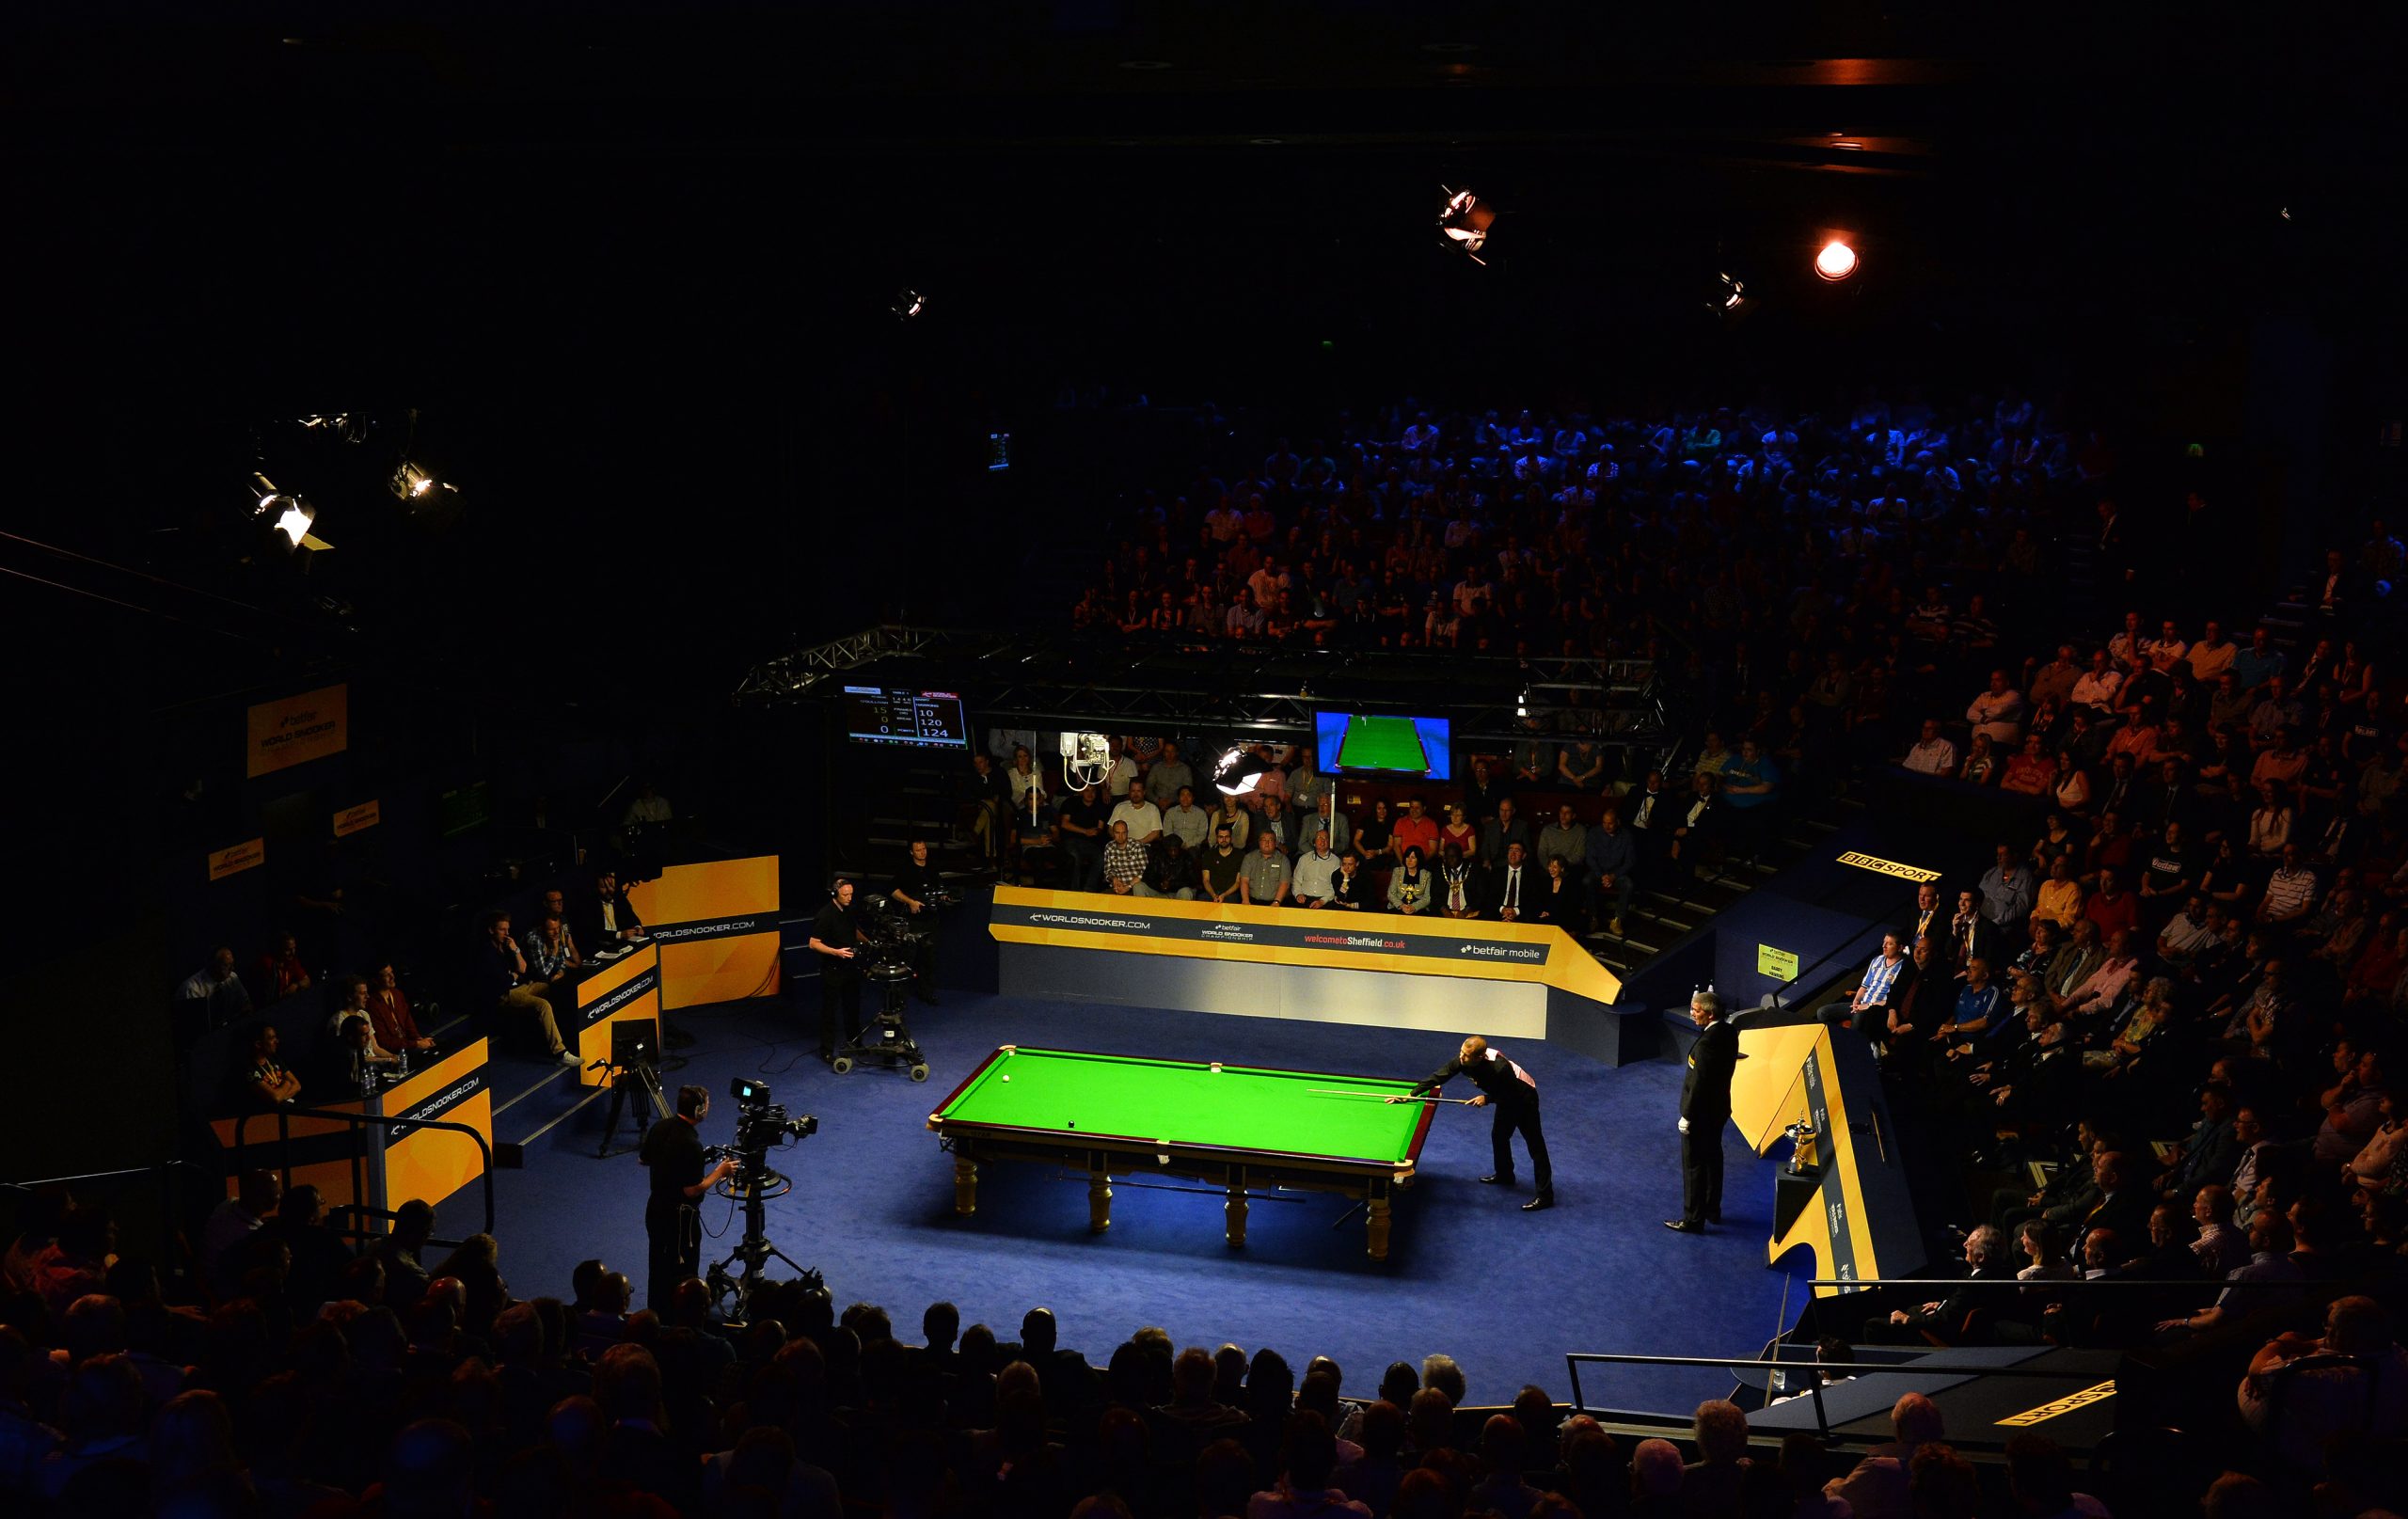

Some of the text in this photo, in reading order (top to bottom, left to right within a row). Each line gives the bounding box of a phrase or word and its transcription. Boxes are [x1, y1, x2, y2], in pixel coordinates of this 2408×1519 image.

[919, 709, 934, 718] 10
[880, 725, 889, 734] 0
[920, 719, 943, 727] 120
[922, 728, 949, 738] 124
[1841, 852, 1940, 881] BBC SPORT
[1041, 913, 1151, 930] WORLDSNOOKER.COM
[1472, 945, 1540, 958] betfair mobile
[594, 974, 654, 1016] WORLDSNOOKER.COM
[2010, 1393, 2103, 1424] SPORT
